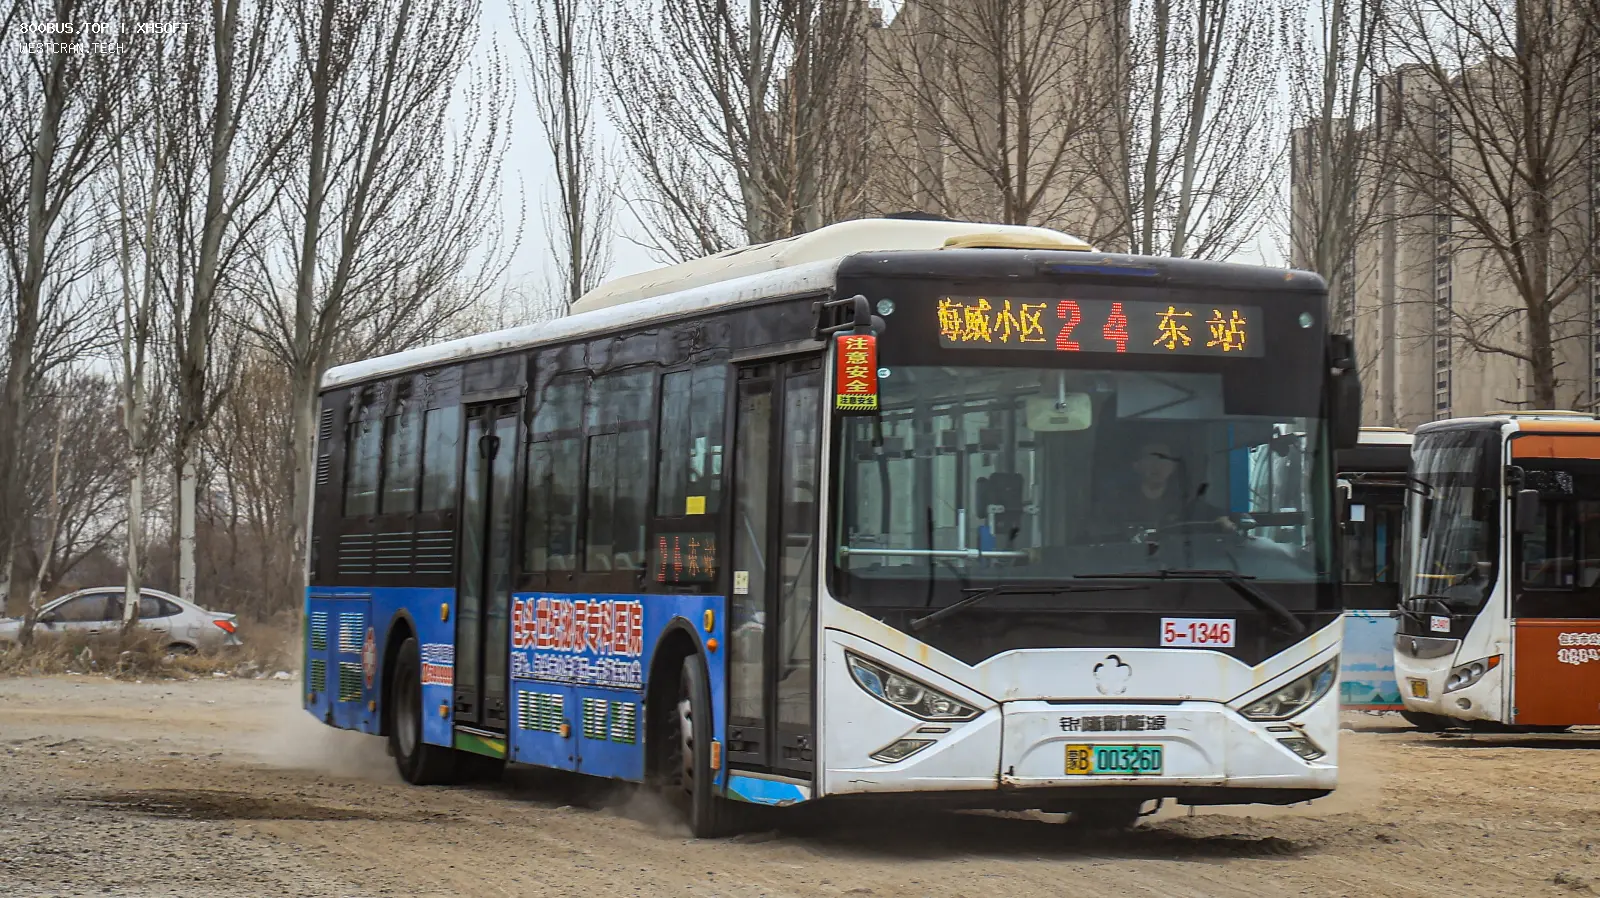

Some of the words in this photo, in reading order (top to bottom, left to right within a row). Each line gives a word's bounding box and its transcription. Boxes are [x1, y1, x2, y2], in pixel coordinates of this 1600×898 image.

[845, 337, 869, 393] 注意安全
[1164, 622, 1231, 644] 5-1346
